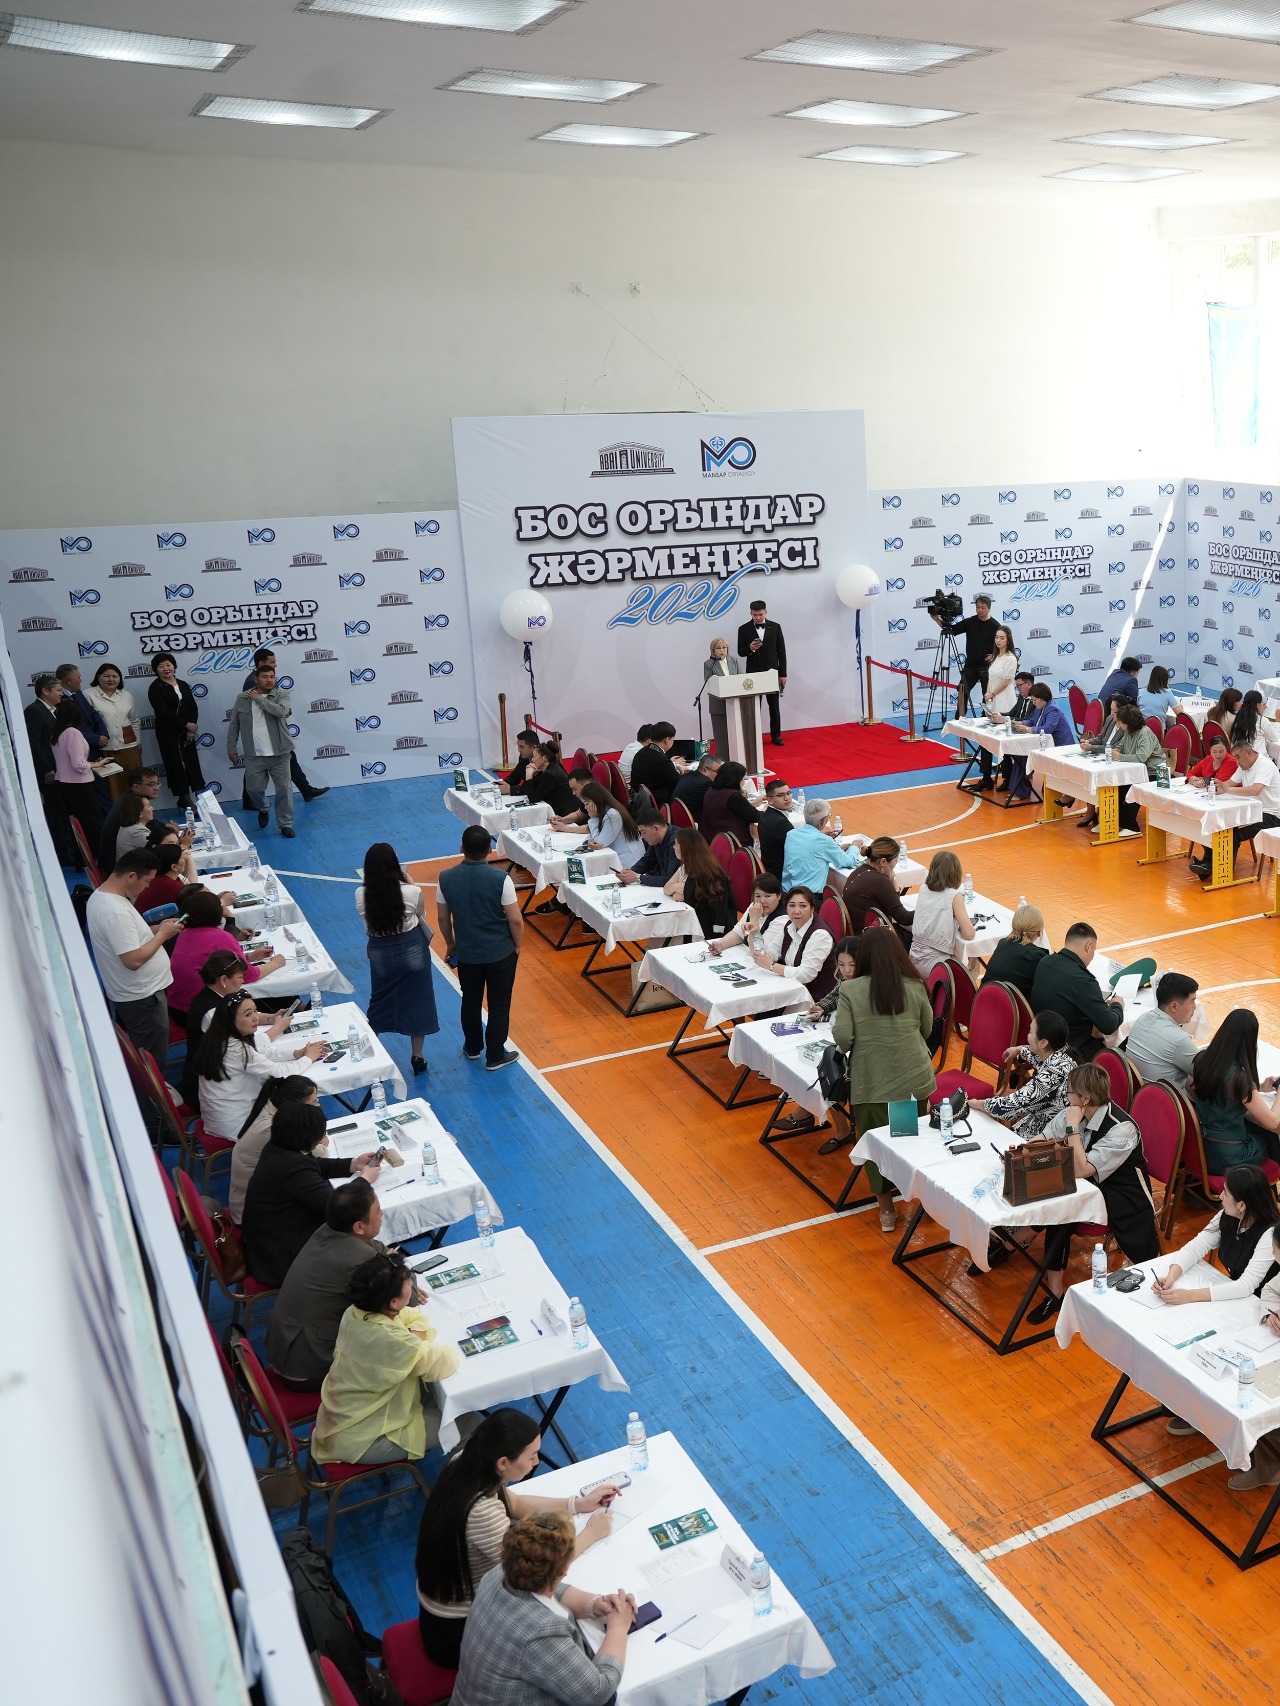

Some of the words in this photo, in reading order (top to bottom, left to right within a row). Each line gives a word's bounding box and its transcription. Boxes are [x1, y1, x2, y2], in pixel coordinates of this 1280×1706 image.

[600, 451, 618, 470] ABAI
[630, 449, 665, 469] UNIVERSITY
[515, 502, 608, 542] БОС
[616, 493, 825, 534] ОРЫНДАР
[528, 536, 819, 588] ЖӘРМЕҢКЕСІ
[978, 550, 1012, 567] БОС
[1014, 543, 1093, 564] ОРЫНДАР
[1208, 542, 1233, 559] БОС
[982, 562, 1090, 586] ЖӘРМЕҢКЕСІ
[607, 562, 771, 629] 2026
[1009, 575, 1073, 602] 2026
[1226, 577, 1270, 600] 2026
[130, 609, 189, 632] БОС
[191, 600, 318, 626] ОРЫНДАР
[142, 622, 317, 655] ЖӘРМЕҢКЕСІ
